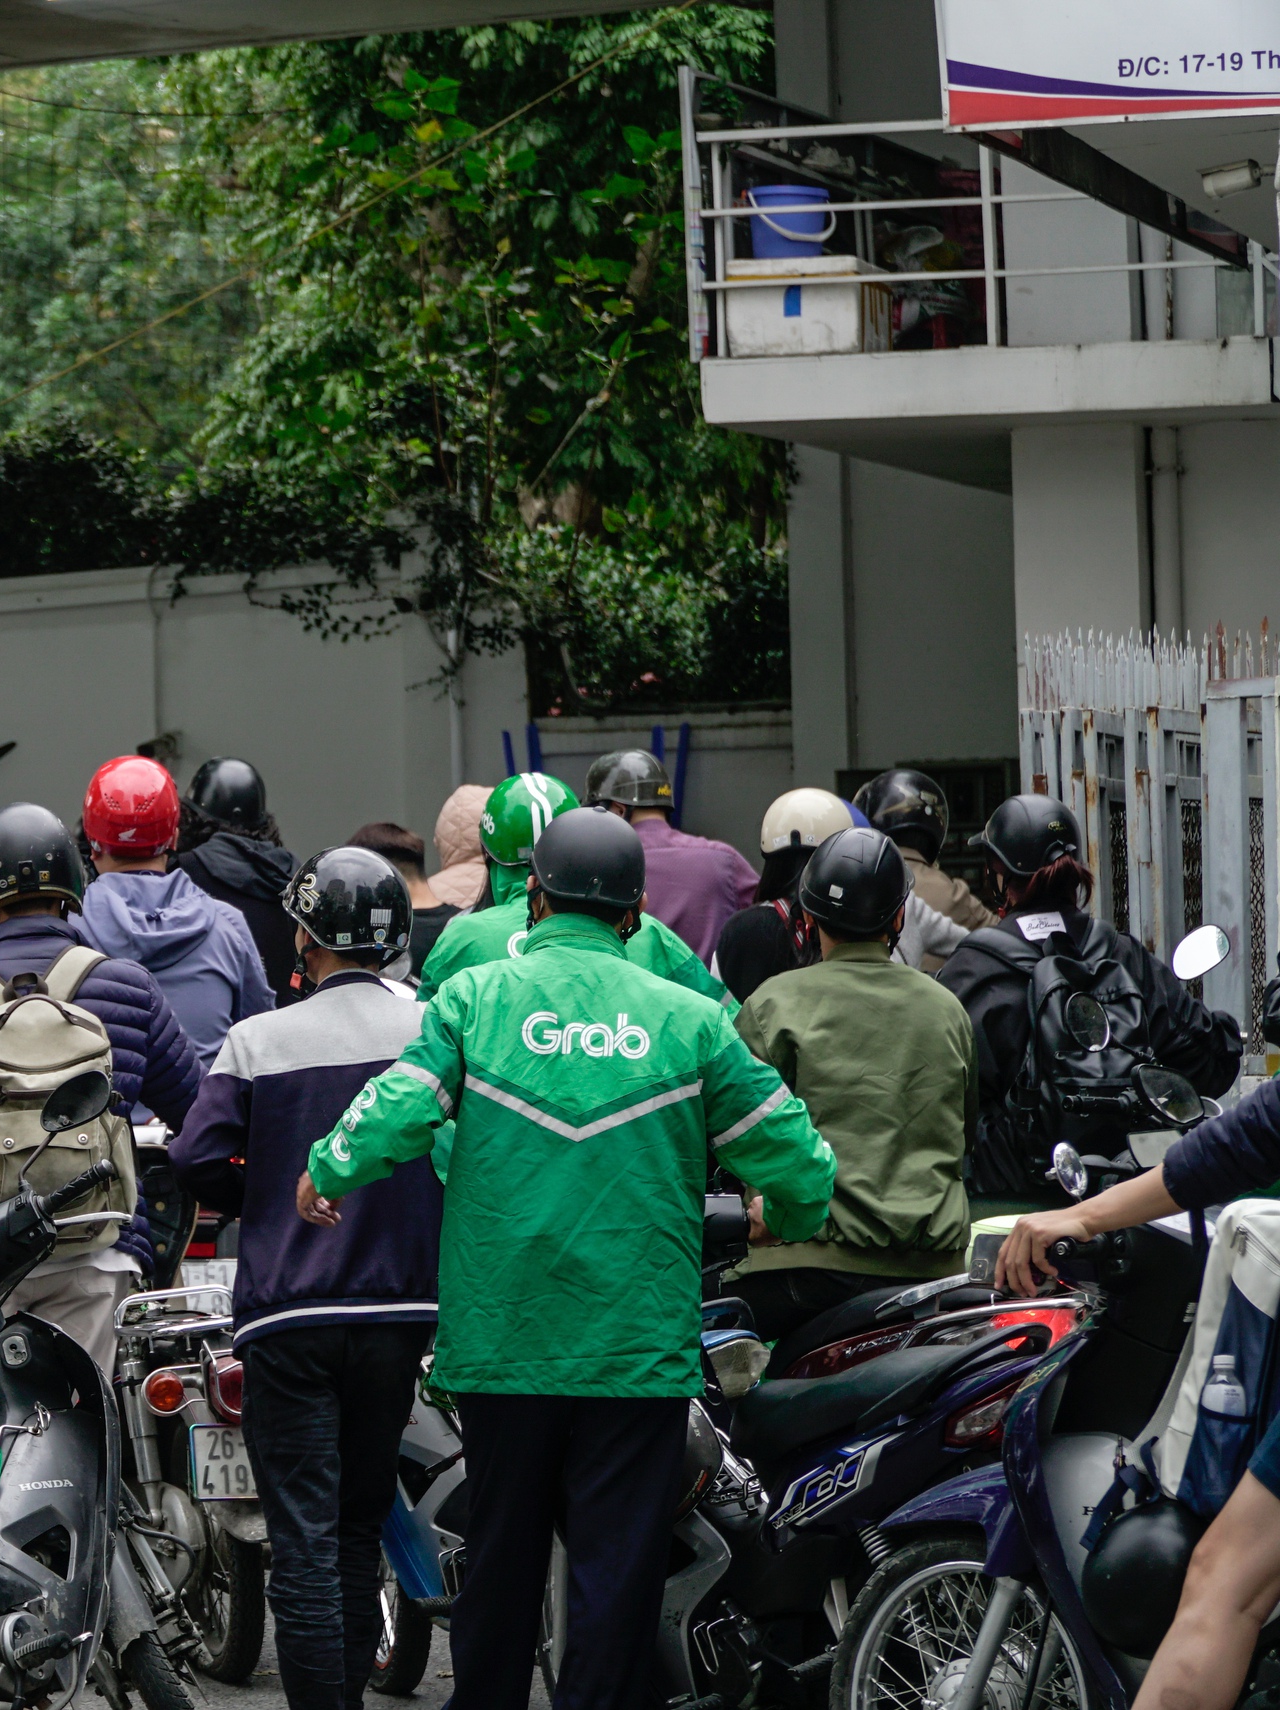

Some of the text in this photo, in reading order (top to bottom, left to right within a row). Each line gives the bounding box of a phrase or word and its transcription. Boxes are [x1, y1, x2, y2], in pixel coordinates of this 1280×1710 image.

[1118, 56, 1169, 77] Đ/C:
[1179, 52, 1243, 73] 17-19
[522, 1011, 650, 1060] Grab
[18, 1479, 74, 1491] HONDA
